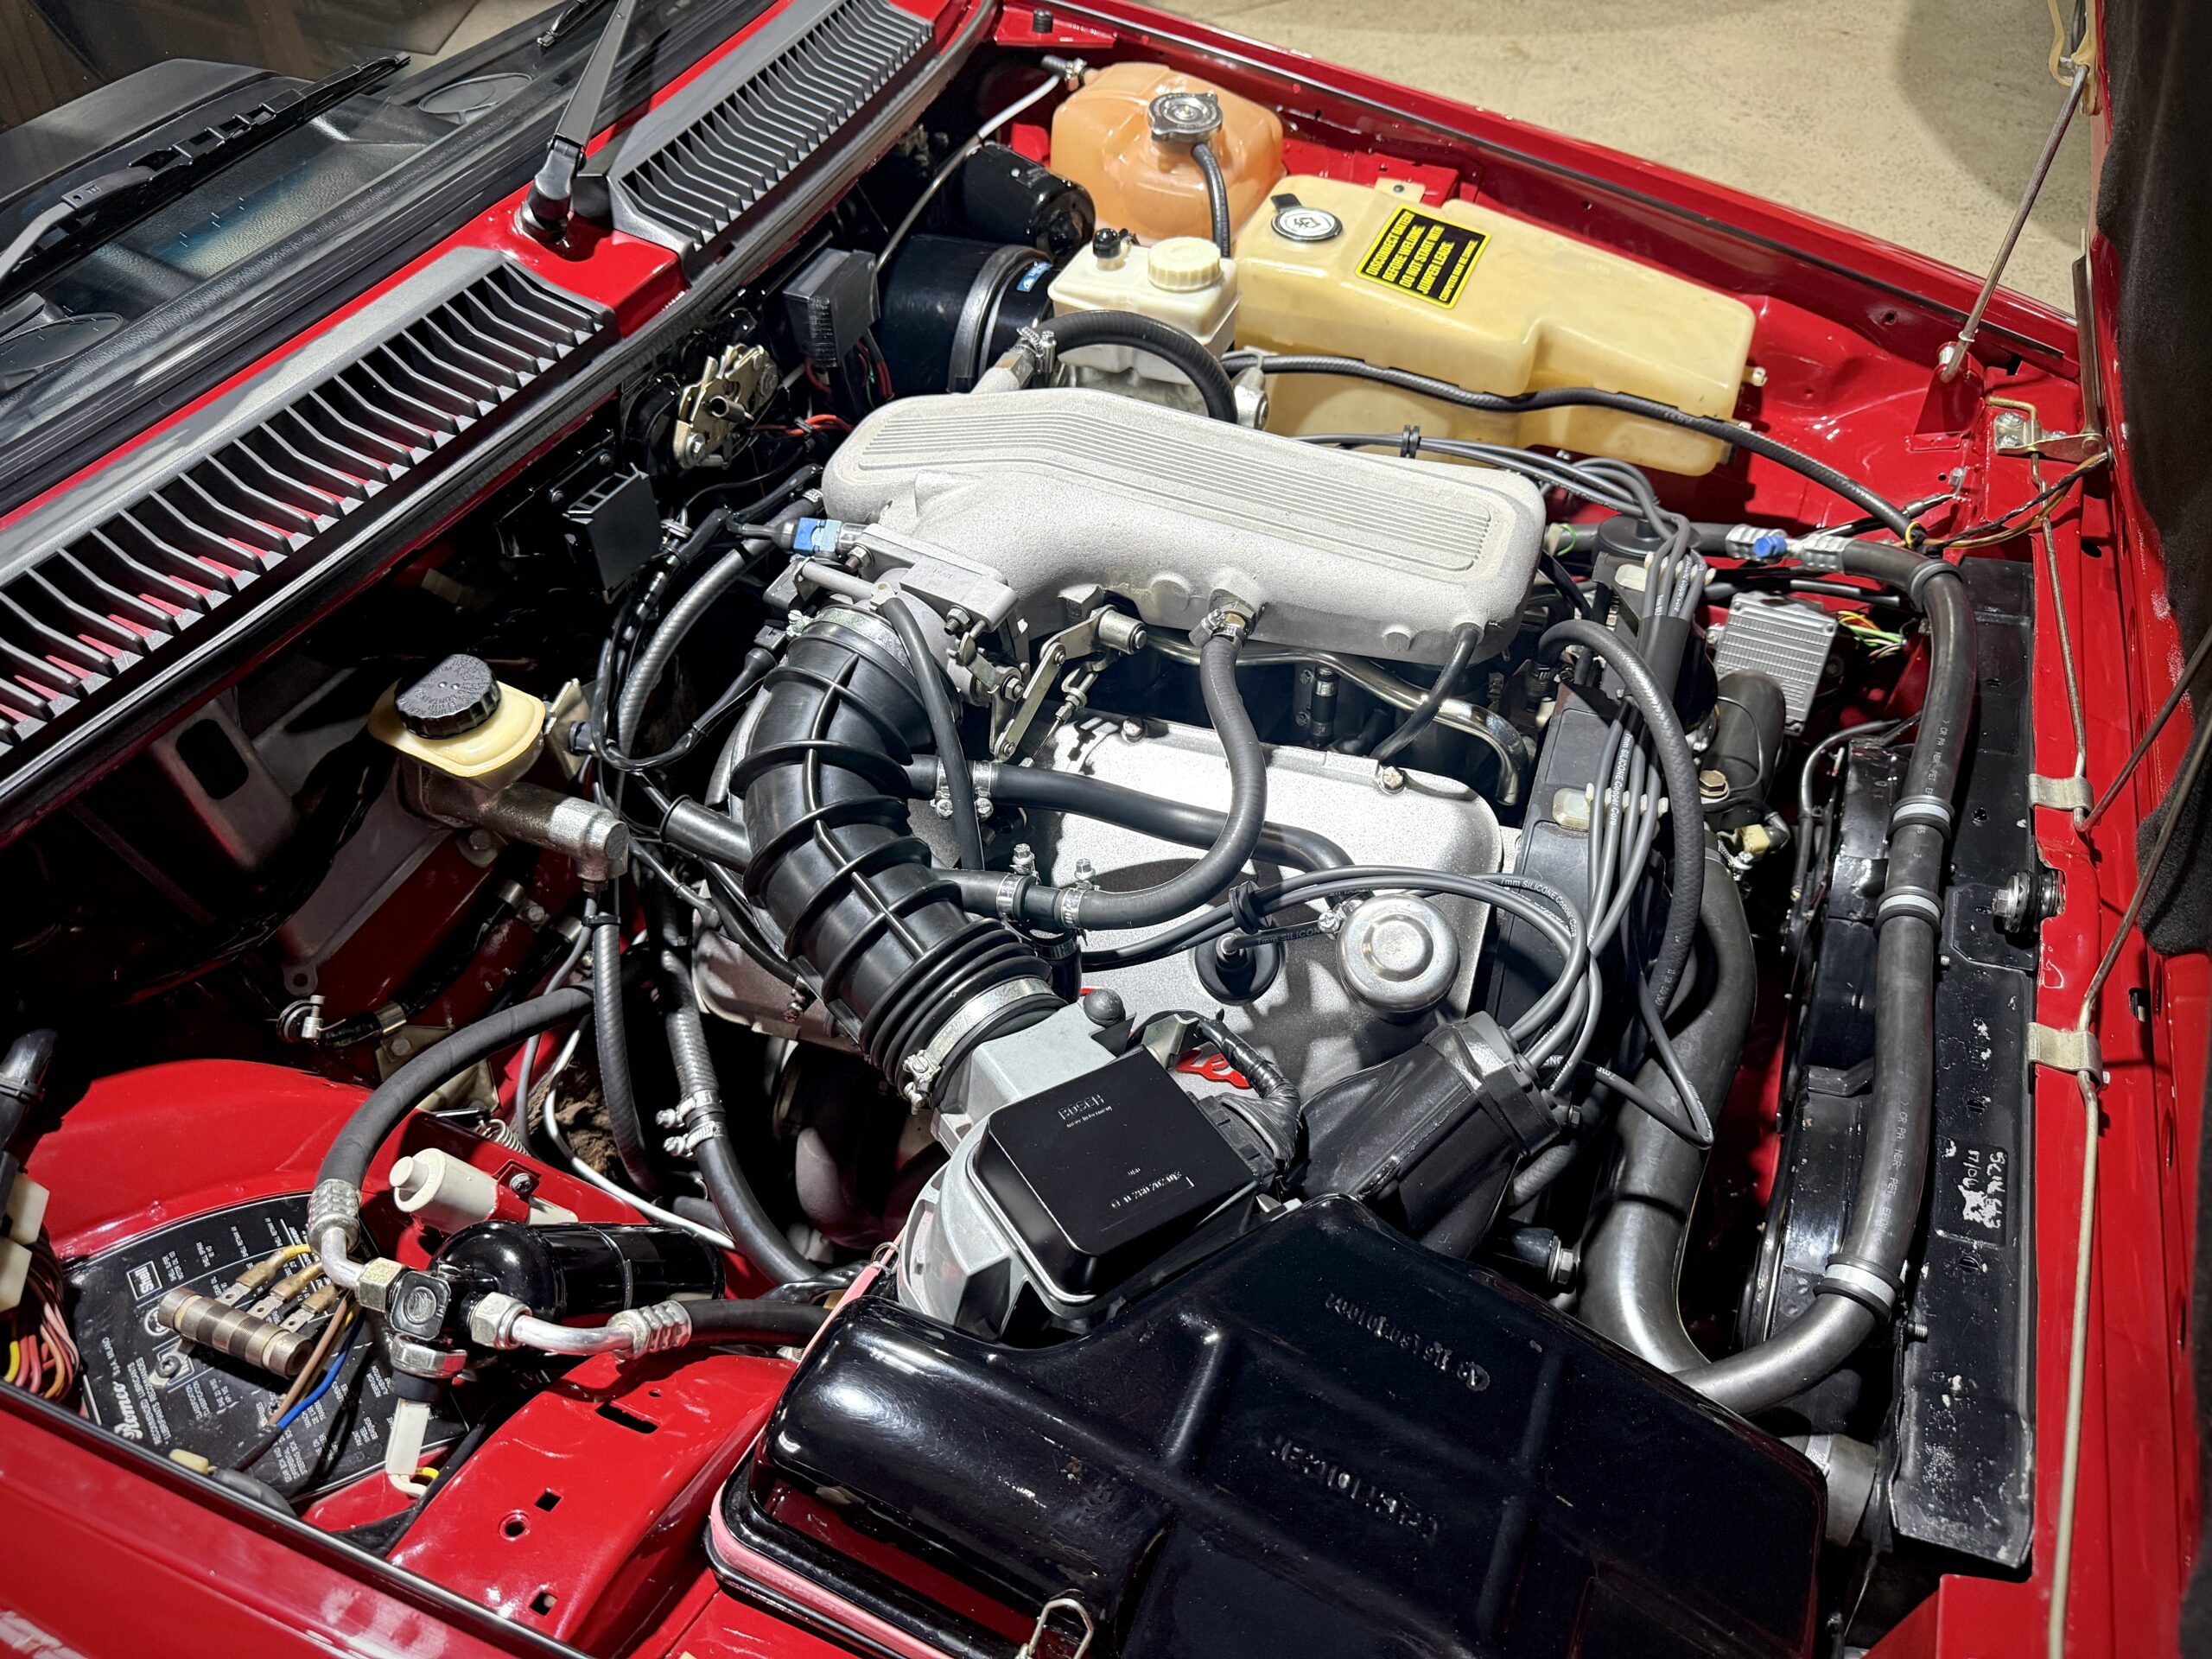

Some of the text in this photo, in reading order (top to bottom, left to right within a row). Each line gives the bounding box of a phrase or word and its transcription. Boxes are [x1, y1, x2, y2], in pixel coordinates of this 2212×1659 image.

[1364, 210, 1414, 276] DISCONNECT BATTERY
[1382, 252, 1407, 282] BEFORE
[1401, 223, 1445, 288] DO NOT START WITH
[1416, 263, 1441, 294] JUMPER
[1438, 274, 1459, 301] COMPUTER
[1452, 263, 1465, 276] MAY
[1615, 748, 1630, 781] SILICONE
[1611, 780, 1623, 805] Copper
[1610, 807, 1619, 826] Core
[1501, 877, 1520, 887] 7mm
[1522, 879, 1556, 902] SILICONE
[1555, 893, 1572, 919] Copper
[1567, 915, 1577, 938] Core
[1280, 928, 1321, 942] SILICON
[1058, 1094, 1104, 1119] BOSCH
[1897, 1111, 1906, 1122] CR
[1897, 1126, 1905, 1139] PA
[1886, 1177, 1896, 1196] PET
[238, 1245, 248, 1257] SHELL
[273, 1235, 283, 1246] SHELL
[200, 1254, 210, 1267] SHELL
[134, 1266, 155, 1294] Shell
[166, 1267, 177, 1281] SHELL
[100, 1336, 115, 1358] MILANO
[365, 1372, 381, 1397] RESERVOIR
[371, 1364, 389, 1395] ALIMENTATION
[111, 1381, 143, 1439] Romeo
[126, 1361, 162, 1445] RECOMMENDED LUBRICANTS
[185, 1383, 202, 1419] CLASSIFICATION
[192, 1380, 210, 1416] CLASSIFICATION
[151, 1402, 171, 1440] LUBRIFIANTS
[311, 1415, 319, 1424] DE
[289, 1440, 298, 1451] BOX
[352, 1429, 363, 1446] FRONT
[359, 1426, 370, 1442] WHEEL
[273, 1446, 283, 1458] AND
[277, 1456, 287, 1468] BOX
[283, 1446, 300, 1478] DIFFERENTIAL
[293, 1451, 308, 1474] STEERING
[282, 1468, 292, 1482] GEAR
